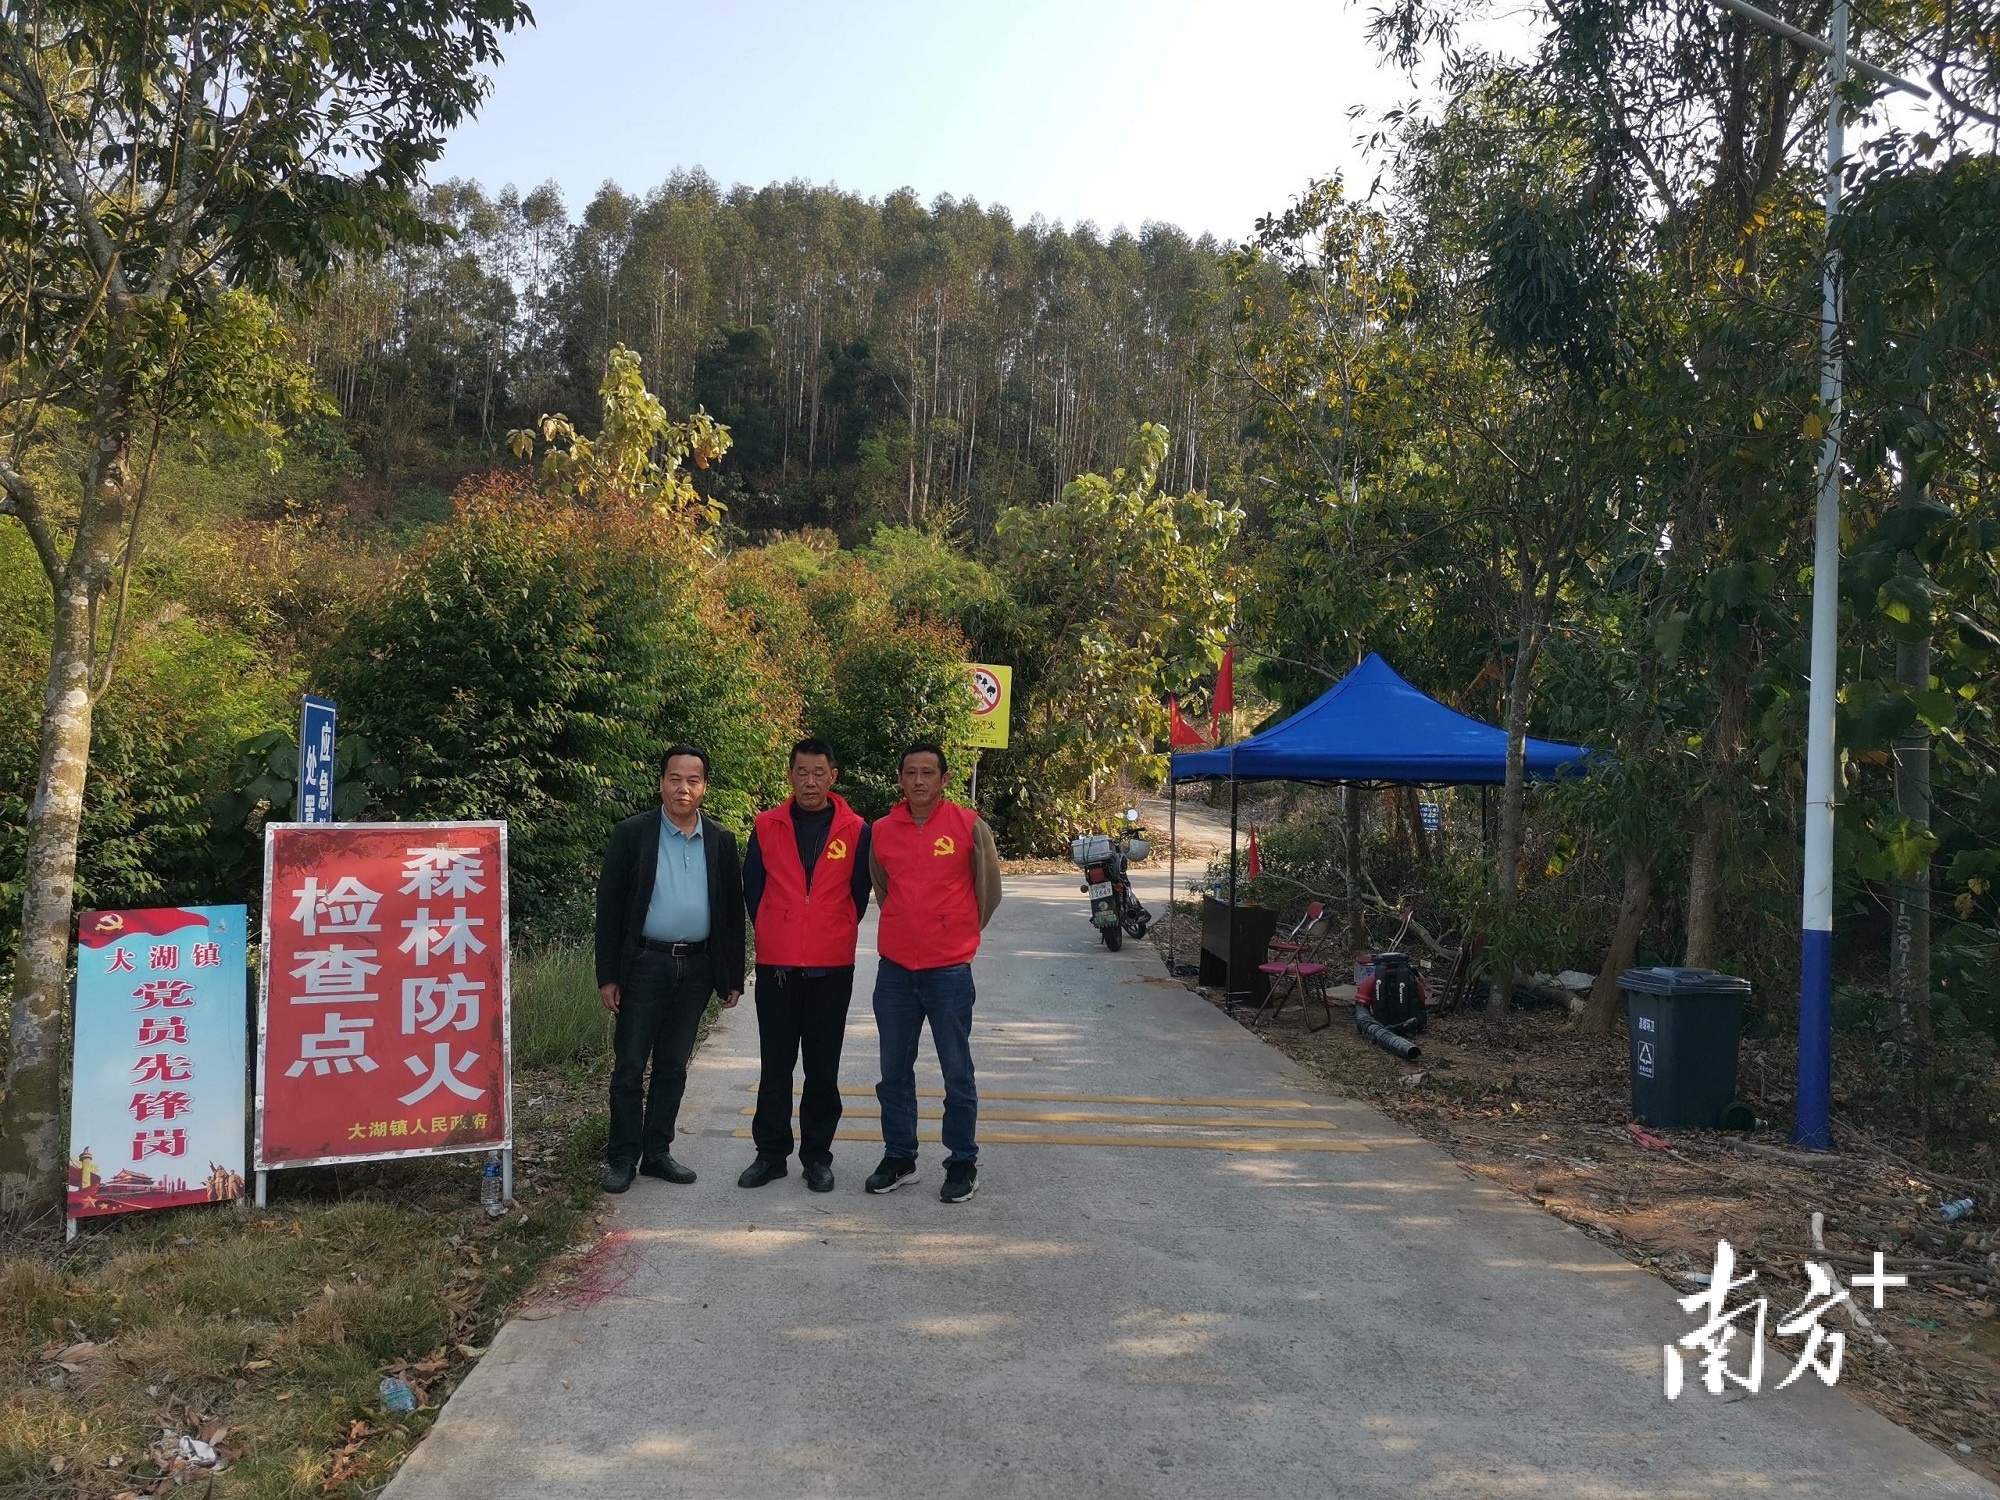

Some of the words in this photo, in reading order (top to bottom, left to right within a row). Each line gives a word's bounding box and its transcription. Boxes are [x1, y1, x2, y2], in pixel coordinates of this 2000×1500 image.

[318, 721, 331, 822] 应急
[104, 942, 222, 974] 大湖镇
[284, 876, 384, 1078] 检查点
[397, 843, 487, 1106] 森林防火
[128, 980, 196, 1162] 党员先锋岗
[347, 1112, 488, 1140] 大湖镇人民政府
